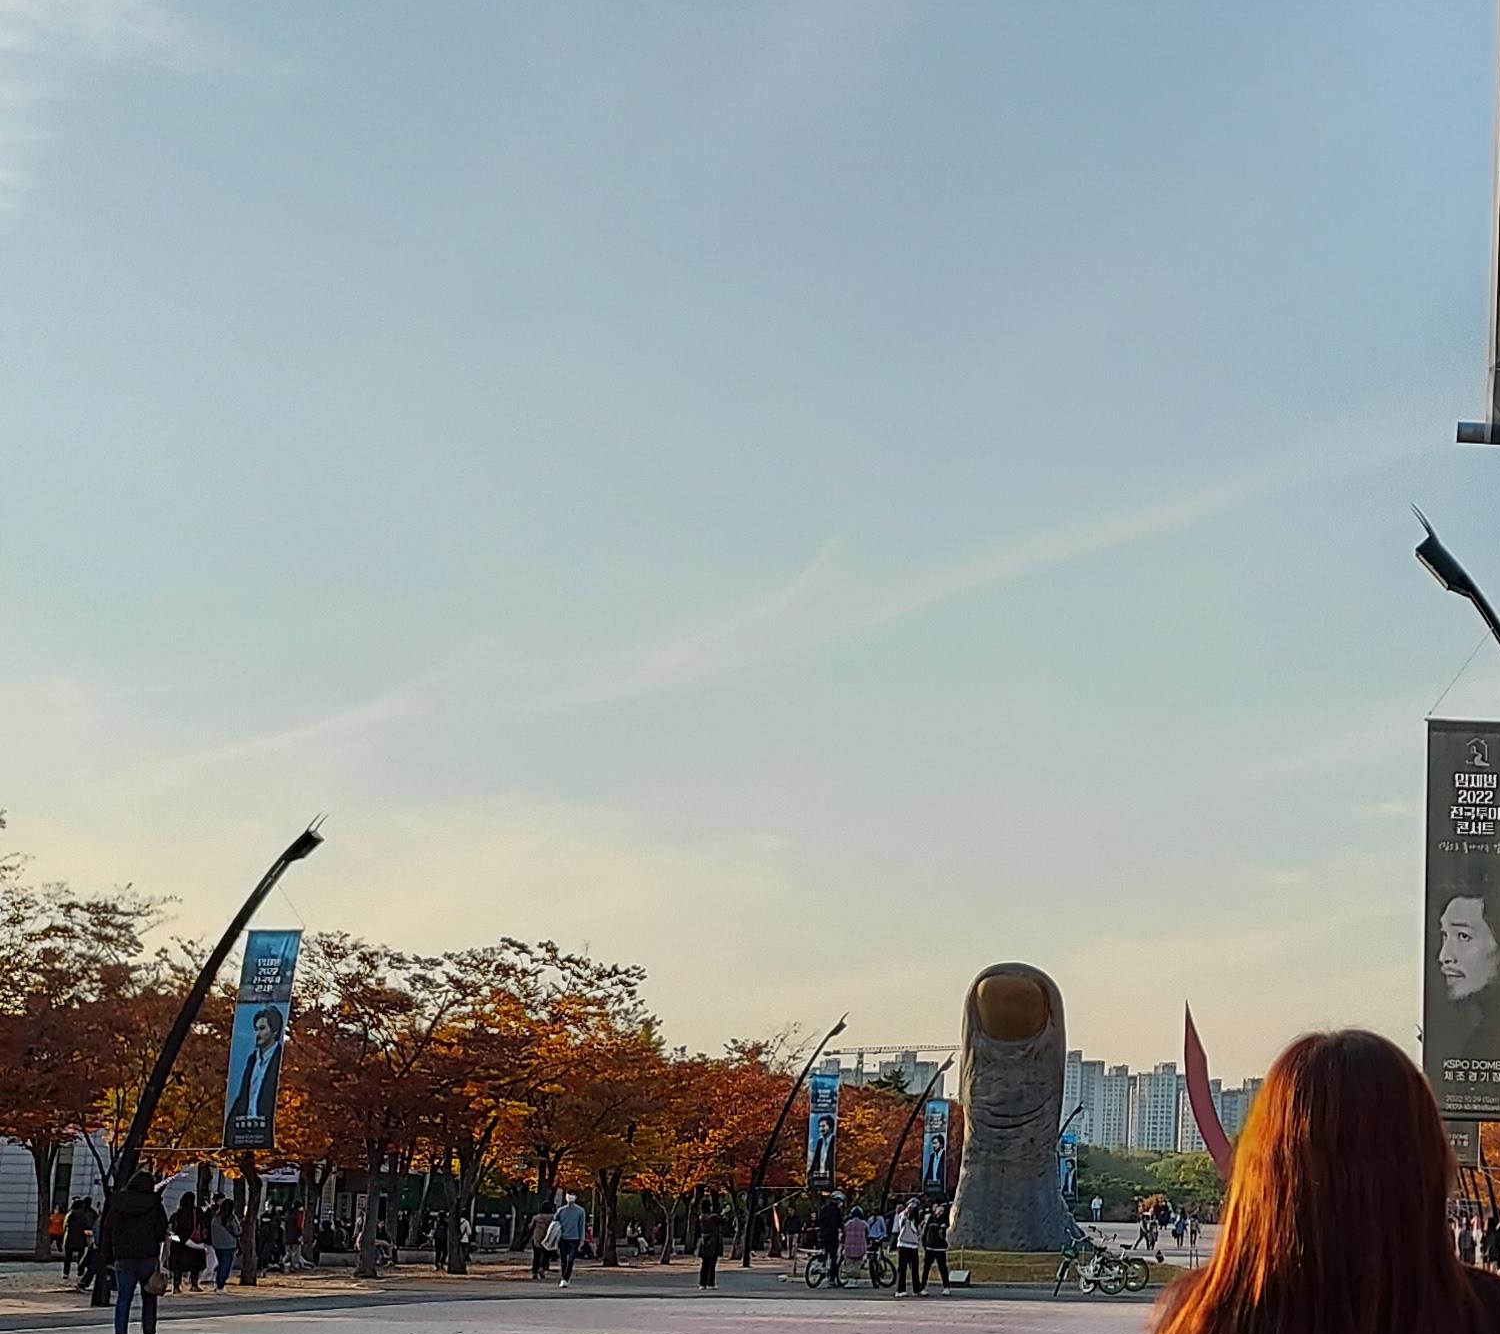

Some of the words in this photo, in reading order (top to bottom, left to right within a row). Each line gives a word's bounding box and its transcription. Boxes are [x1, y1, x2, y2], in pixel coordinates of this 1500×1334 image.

[1457, 789, 1494, 804] 2022
[1456, 821, 1495, 835] 콘서트
[1443, 1059, 1470, 1070] KSPO
